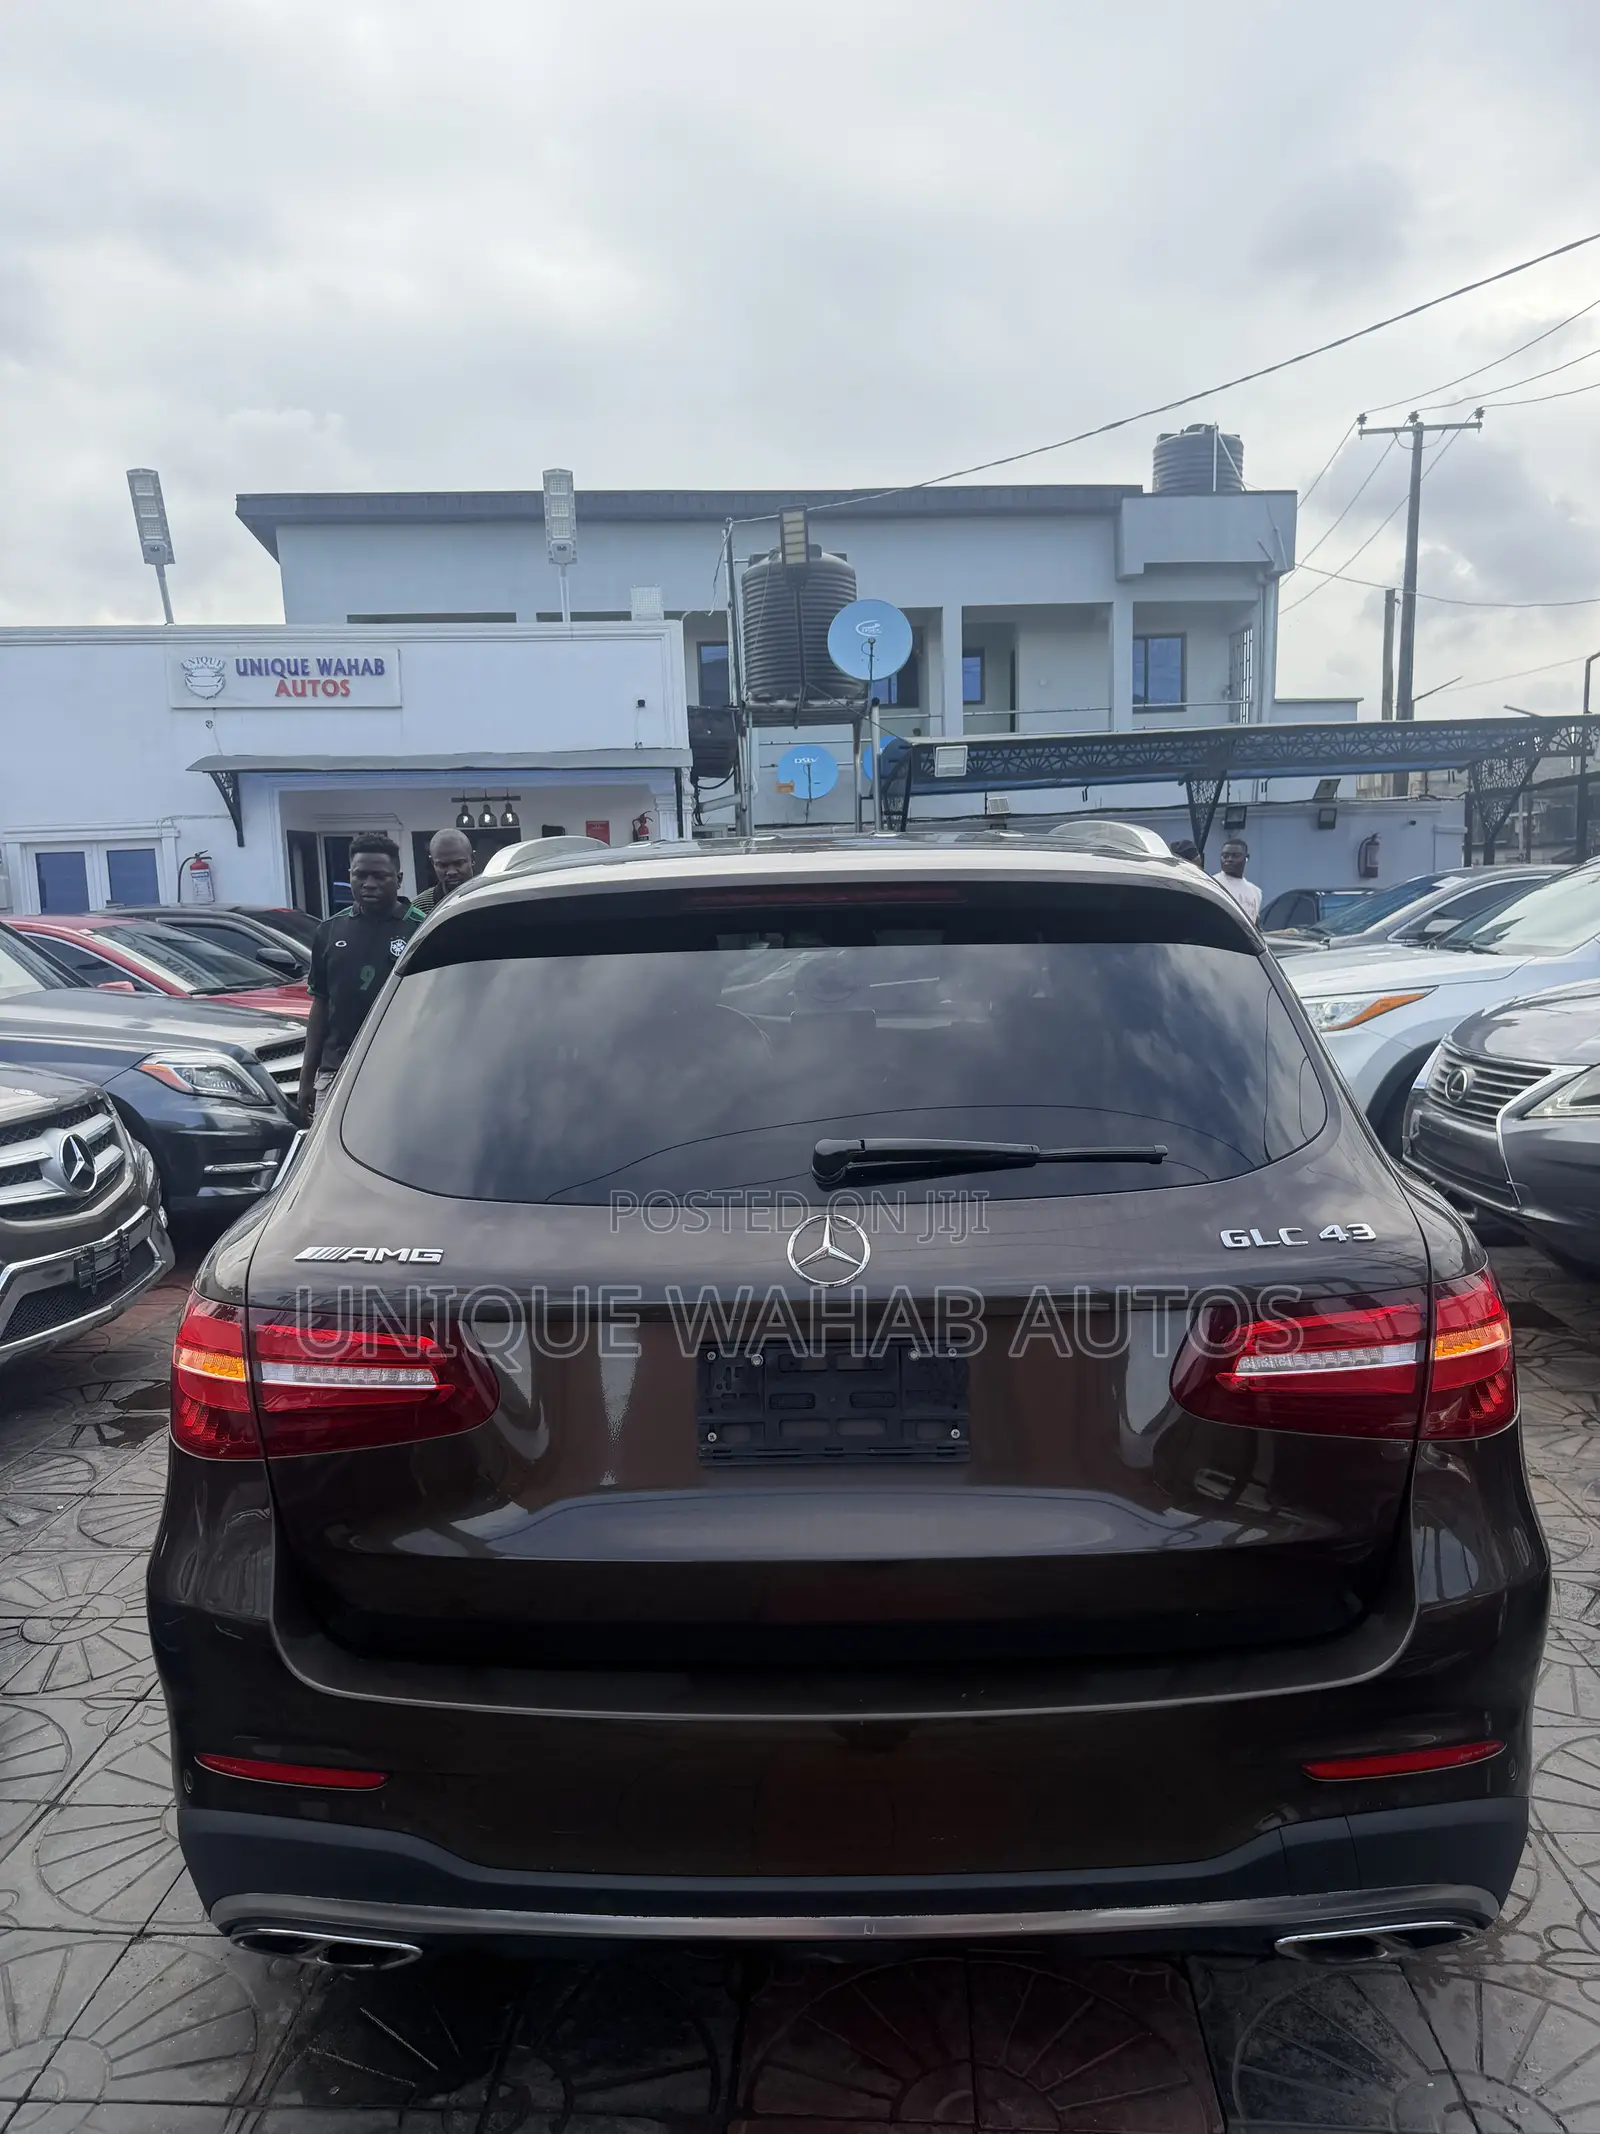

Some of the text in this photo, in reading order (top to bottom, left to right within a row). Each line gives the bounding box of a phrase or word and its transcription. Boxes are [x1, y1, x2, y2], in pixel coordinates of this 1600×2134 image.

[181, 656, 226, 671] UNIQUE
[235, 658, 385, 678] UNIQUE WAHAB
[275, 679, 350, 697] AUTOS
[360, 965, 375, 990] 9
[1220, 1223, 1376, 1248] GLC 43
[340, 1247, 444, 1263] AMG
